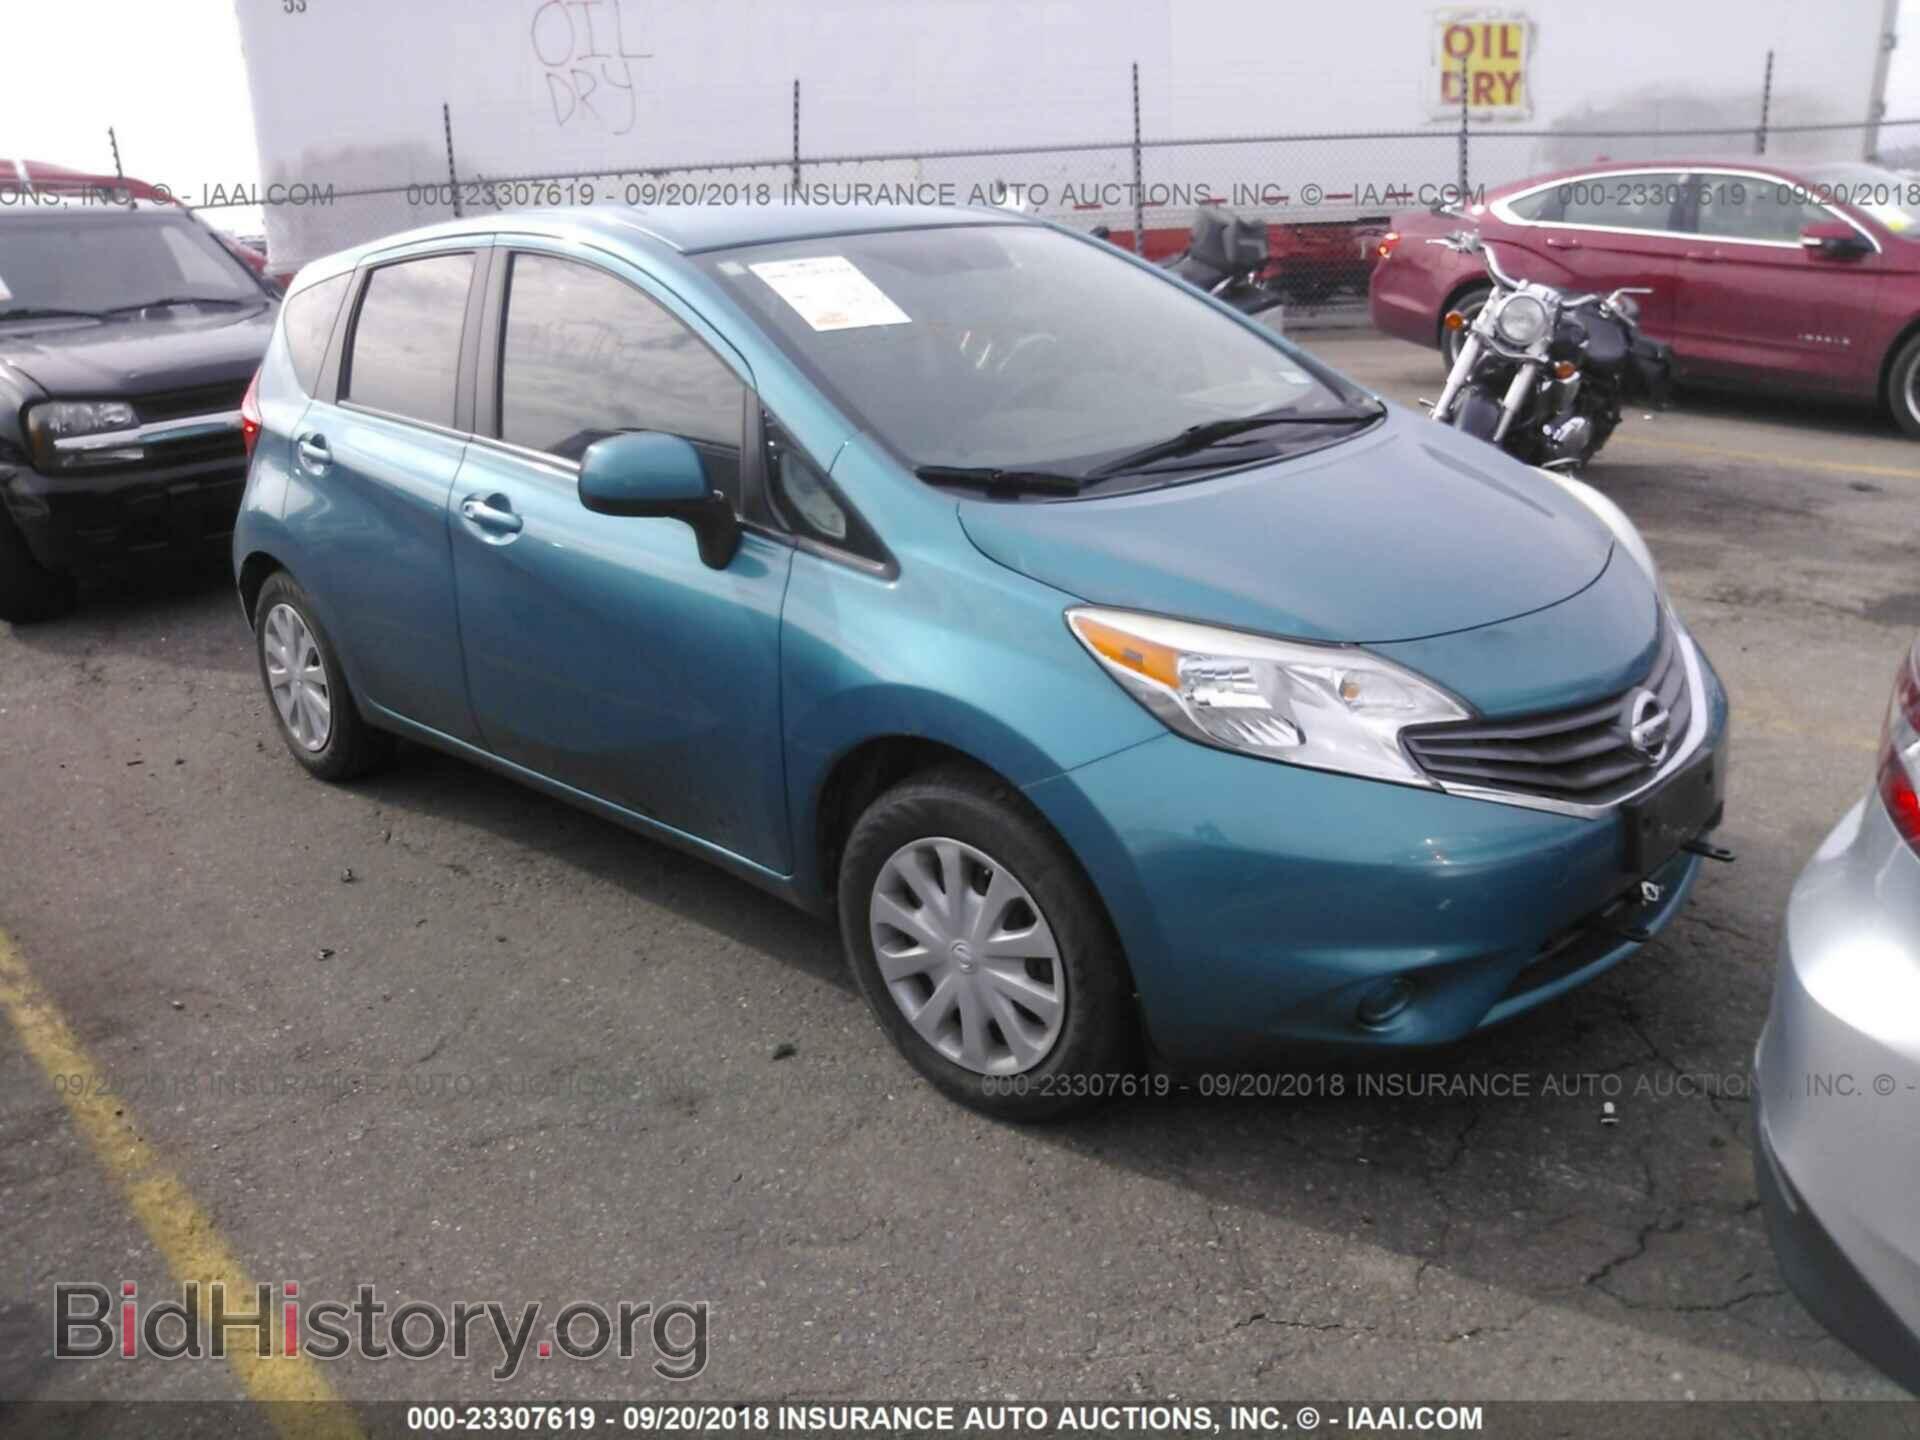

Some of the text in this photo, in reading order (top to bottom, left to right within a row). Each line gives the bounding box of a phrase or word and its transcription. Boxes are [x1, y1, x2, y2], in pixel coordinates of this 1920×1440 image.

[529, 0, 655, 67] OIL
[1443, 23, 1519, 59] OIL
[545, 61, 637, 136] DRY
[1442, 70, 1521, 105] DRY
